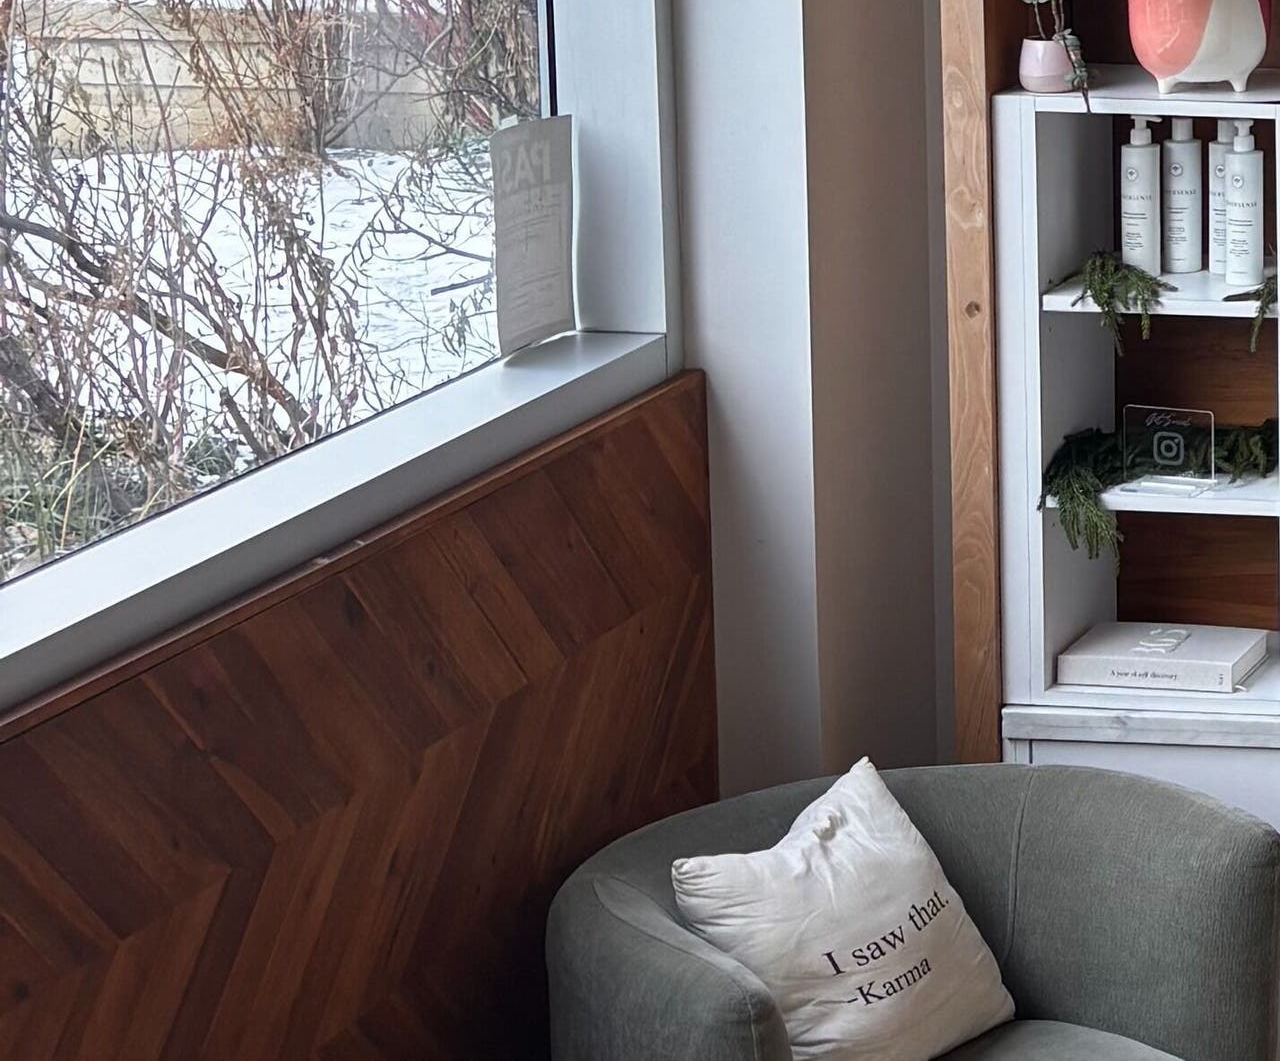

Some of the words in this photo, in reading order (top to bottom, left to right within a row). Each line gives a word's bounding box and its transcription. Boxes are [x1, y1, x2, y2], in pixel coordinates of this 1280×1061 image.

[822, 951, 846, 977] I
[851, 925, 906, 967] saw
[908, 889, 951, 932] that.
[846, 956, 932, 1007] -Karma
